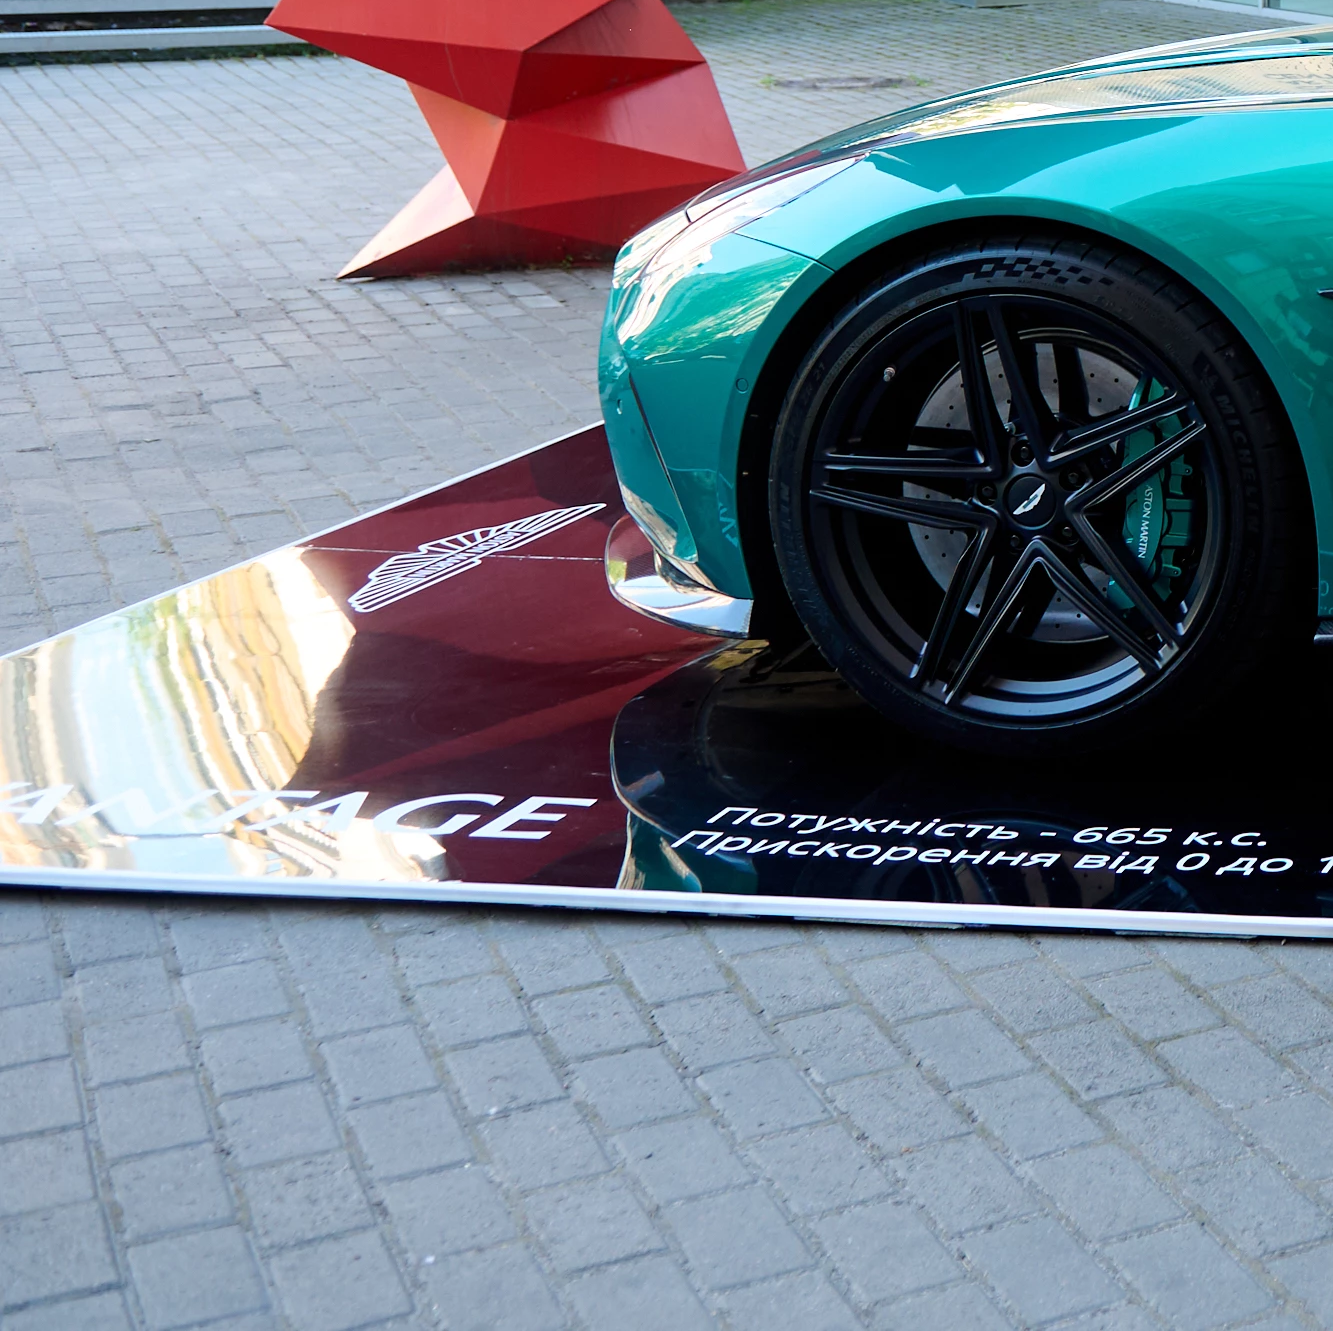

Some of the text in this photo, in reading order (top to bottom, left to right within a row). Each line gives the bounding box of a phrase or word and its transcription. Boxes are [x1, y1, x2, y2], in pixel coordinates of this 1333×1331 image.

[1215, 392, 1261, 537] MICHELIN
[1138, 484, 1153, 559] ASTON MARTIN
[0, 781, 598, 841] ANTAGE
[706, 806, 1020, 840] Потужність
[1073, 826, 1173, 845] 665
[1183, 831, 1268, 847] к.с.
[671, 830, 1063, 868] Прискорення
[1074, 852, 1156, 875] від
[1176, 853, 1210, 871] 0
[1215, 858, 1294, 876] до
